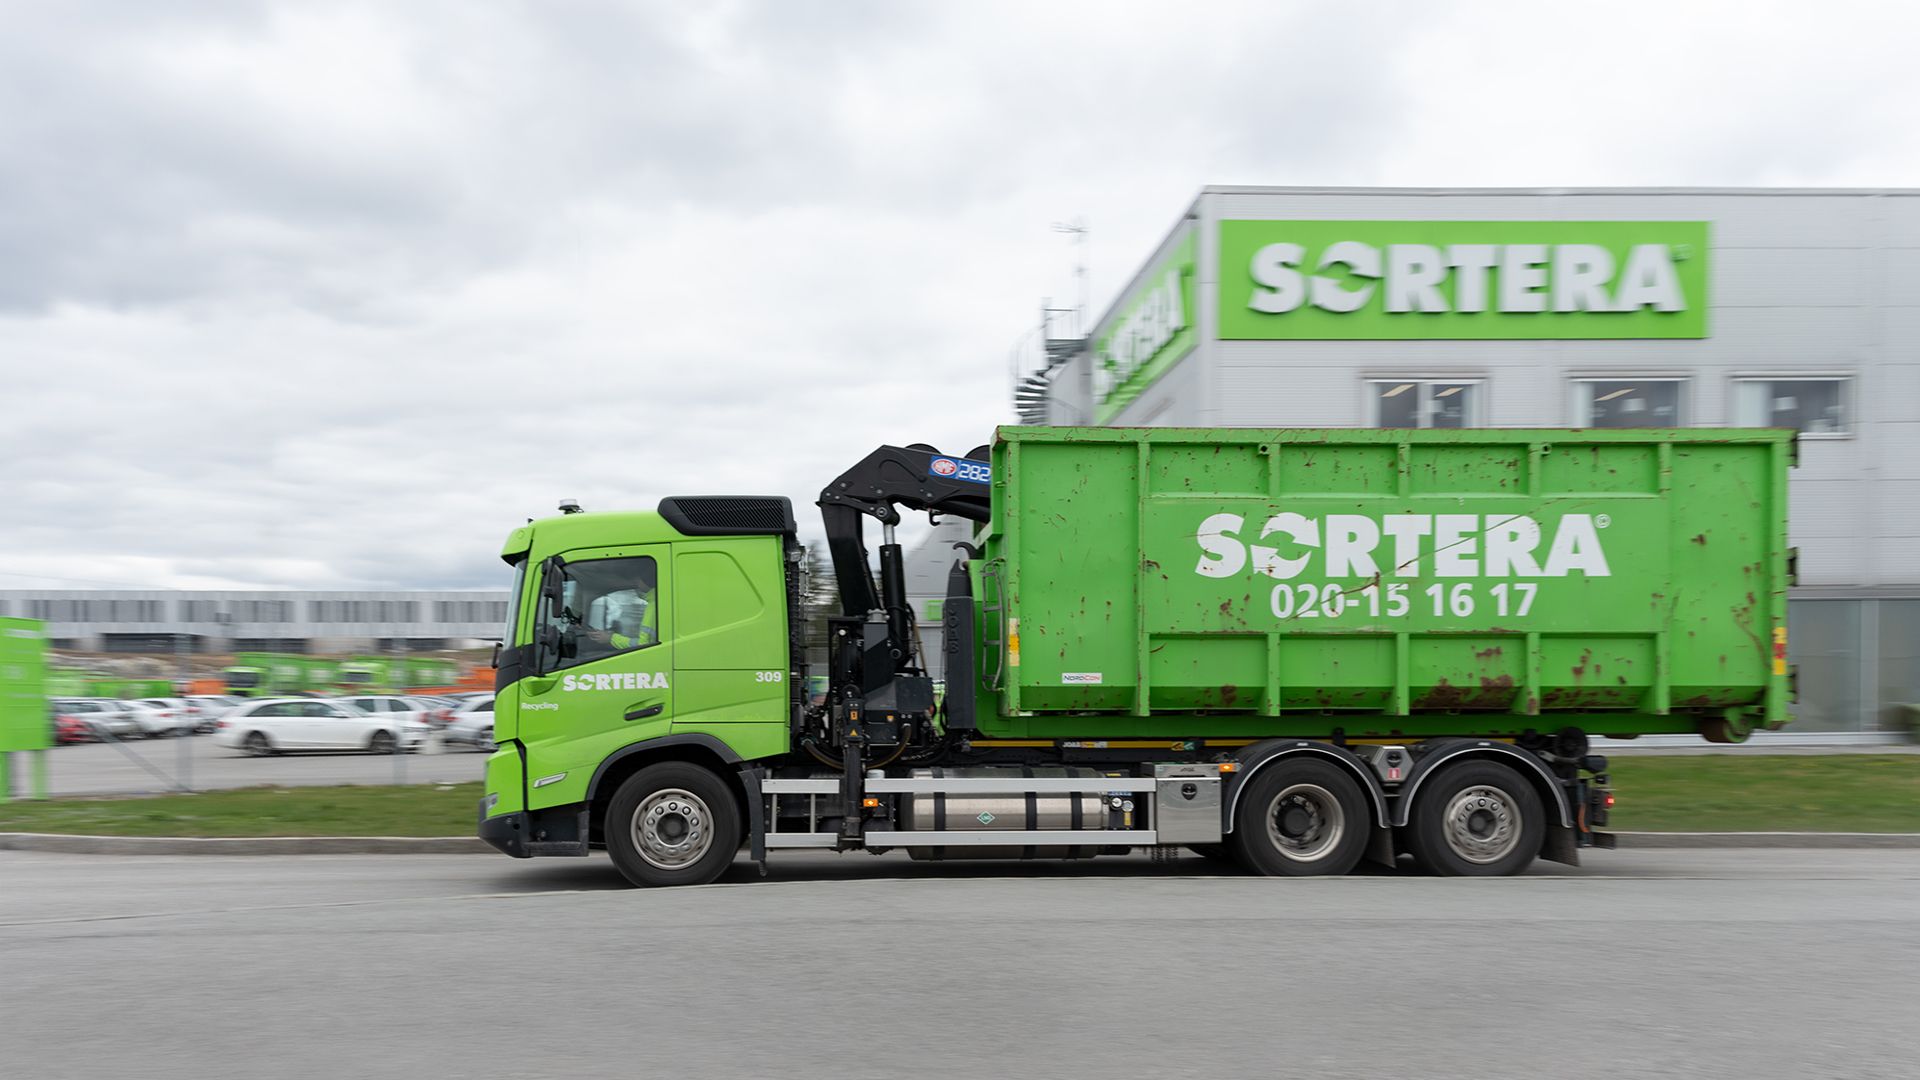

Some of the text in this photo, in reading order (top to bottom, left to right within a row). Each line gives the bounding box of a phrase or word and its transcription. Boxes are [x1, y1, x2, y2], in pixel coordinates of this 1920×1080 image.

[1247, 241, 1686, 314] SORTERA
[959, 463, 991, 481] 282
[1194, 512, 1611, 579] SORTERA
[1270, 582, 1538, 618] 020-15 16 17
[562, 672, 669, 691] SORTERA
[755, 671, 782, 683] 309
[521, 702, 559, 712] Recycling
